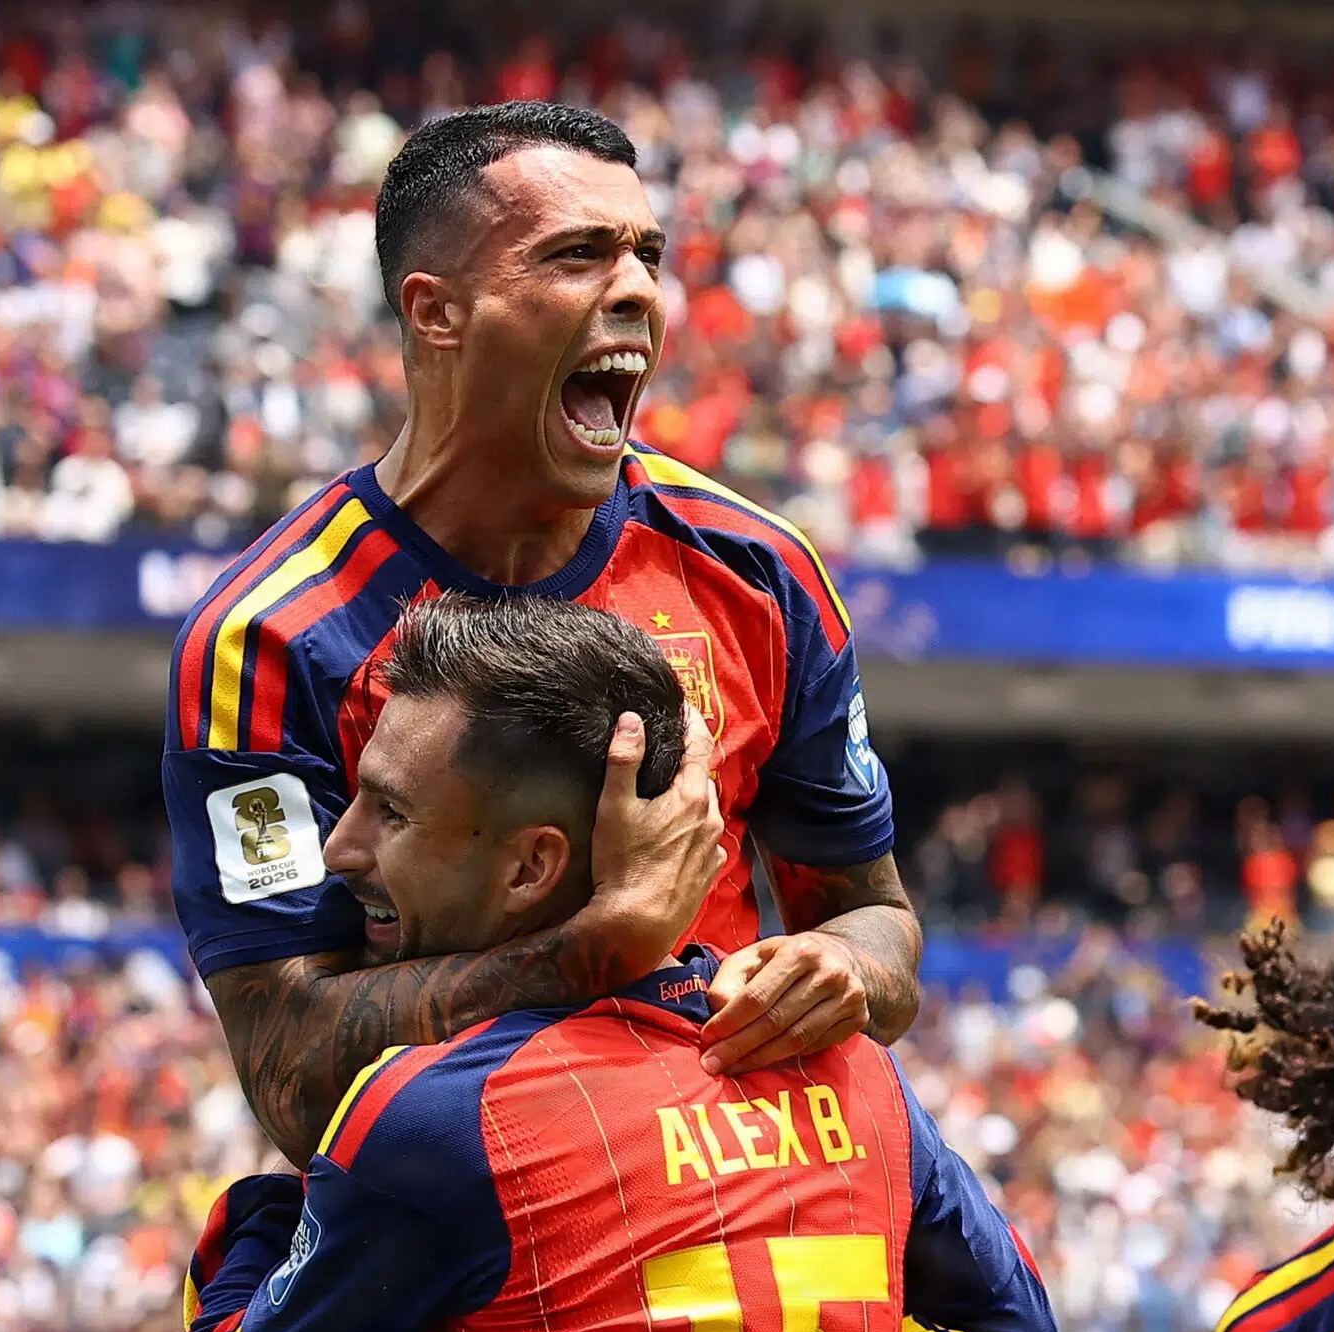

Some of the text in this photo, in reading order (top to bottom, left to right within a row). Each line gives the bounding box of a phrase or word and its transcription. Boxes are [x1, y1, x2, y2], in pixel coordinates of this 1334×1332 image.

[248, 860, 296, 877] WORLD CUP
[248, 869, 299, 890] 2026
[656, 1084, 867, 1186] ALEX B.
